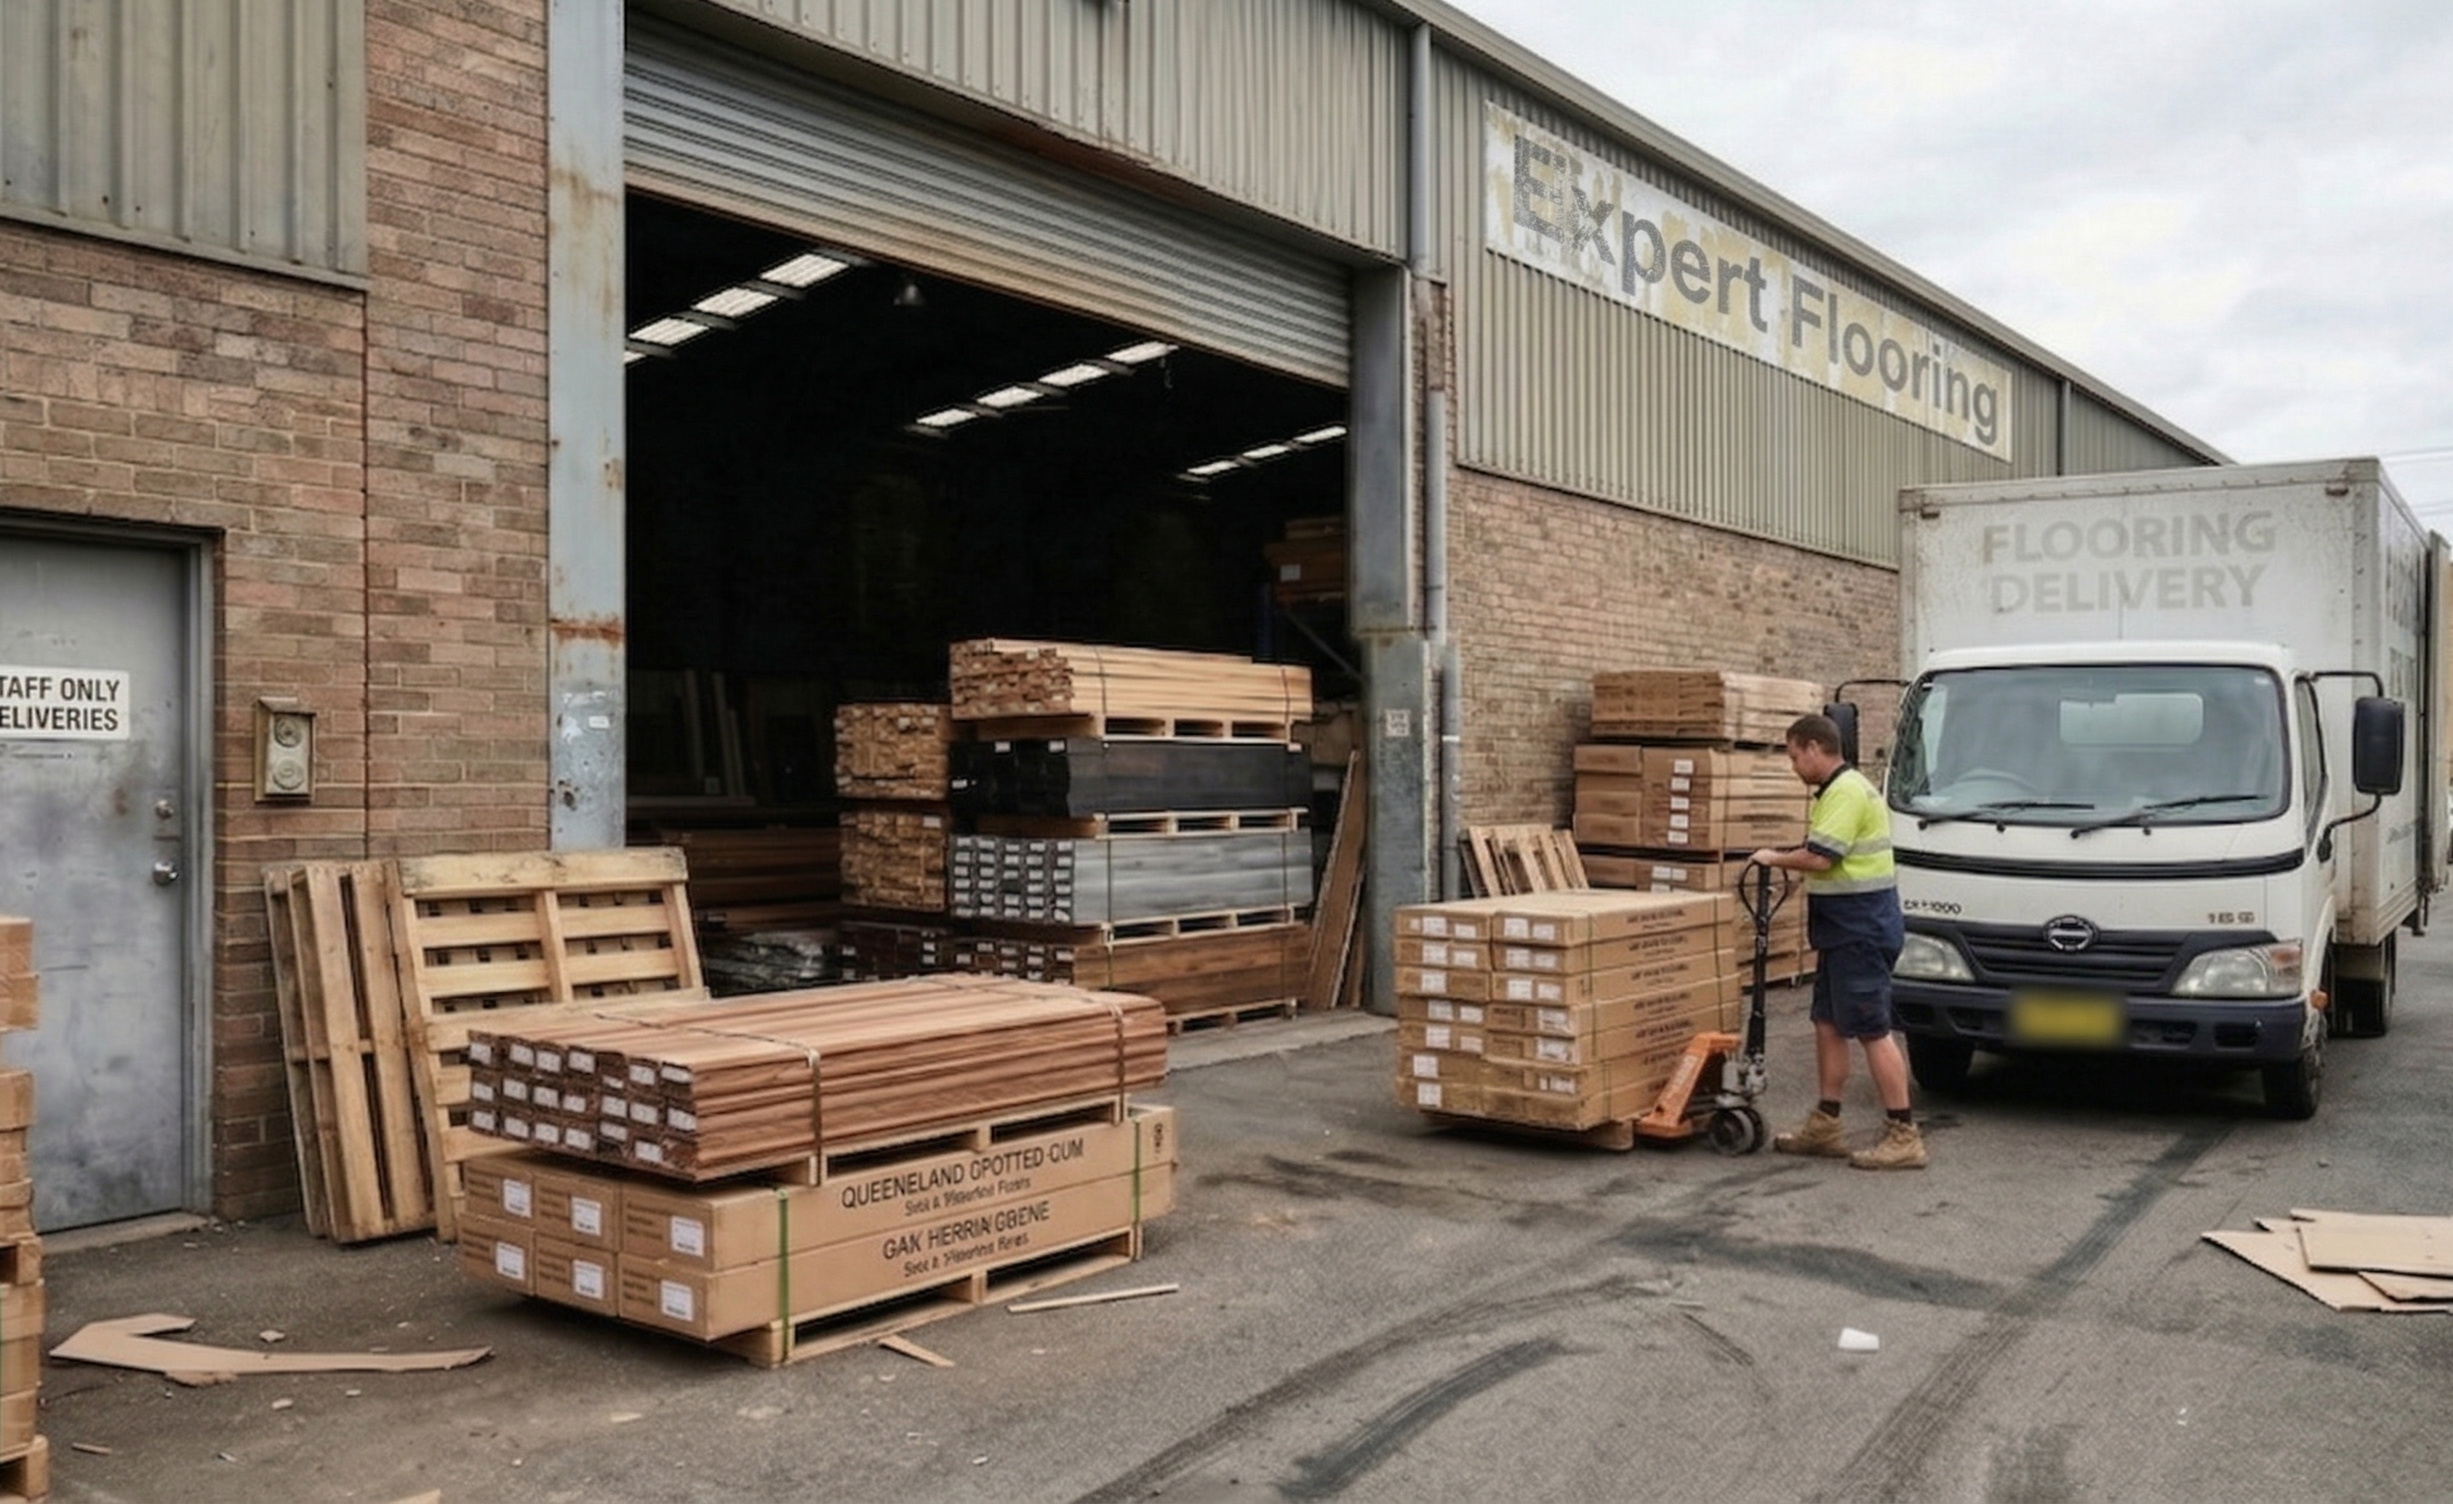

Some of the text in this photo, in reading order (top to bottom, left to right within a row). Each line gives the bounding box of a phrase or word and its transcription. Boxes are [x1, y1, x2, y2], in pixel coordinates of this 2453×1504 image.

[1513, 133, 1998, 446] Expert Flooring
[1981, 510, 2276, 565] FLOORING
[1989, 564, 2267, 614] DELIVERY
[60, 678, 120, 702] ONLY
